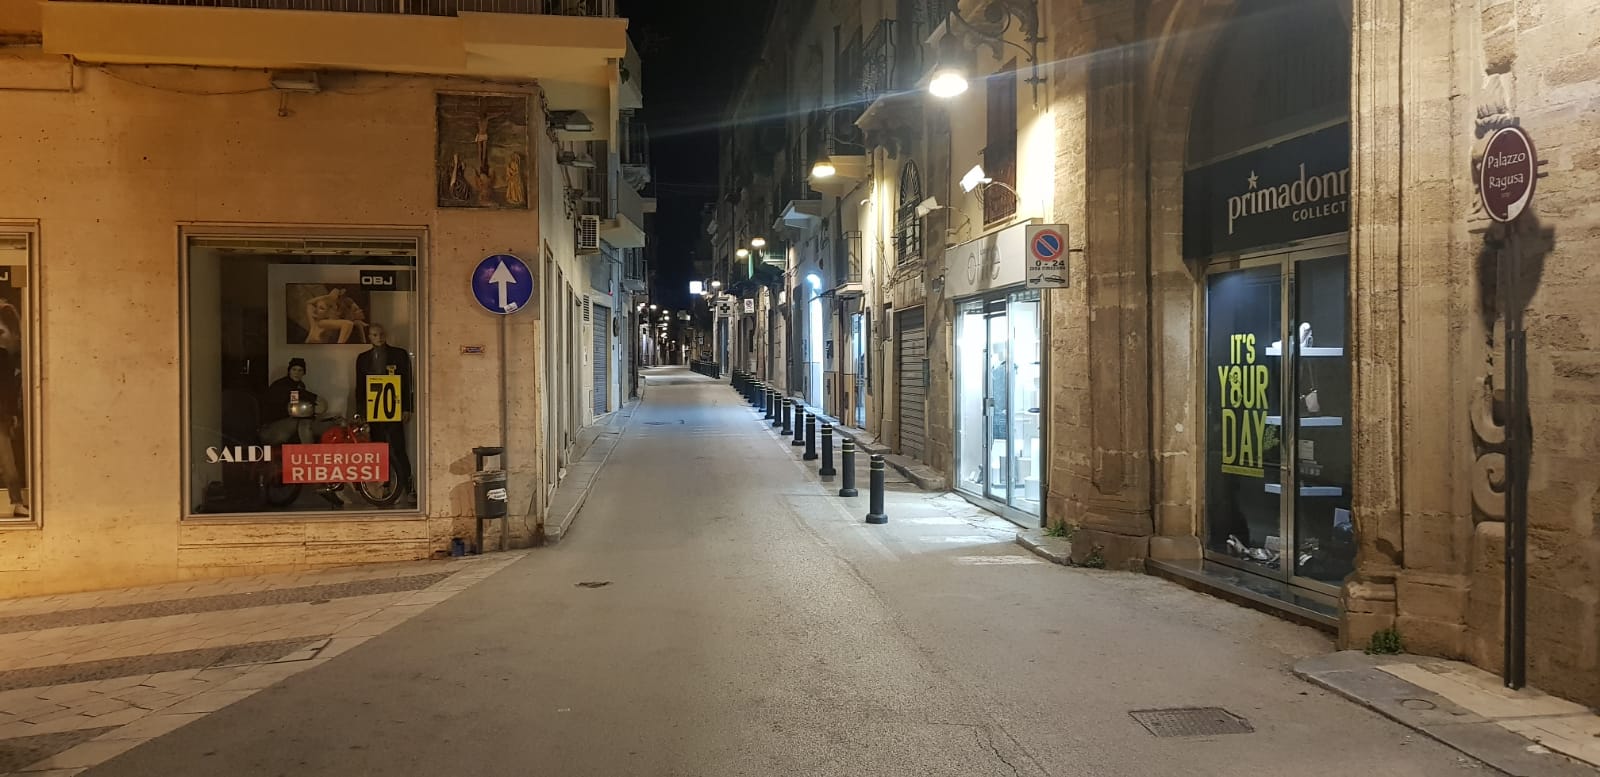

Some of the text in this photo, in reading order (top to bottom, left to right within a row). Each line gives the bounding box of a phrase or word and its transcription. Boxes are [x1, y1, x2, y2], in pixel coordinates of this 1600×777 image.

[1487, 152, 1526, 169] Palazzo
[1489, 173, 1524, 190] Ragusa
[361, 275, 393, 286] OBJ
[1230, 333, 1256, 365] IT'S
[1222, 408, 1268, 468] DAY
[206, 445, 272, 464] SALDI
[291, 452, 381, 465] ULTERIORI
[292, 466, 381, 482] RIBASSI
